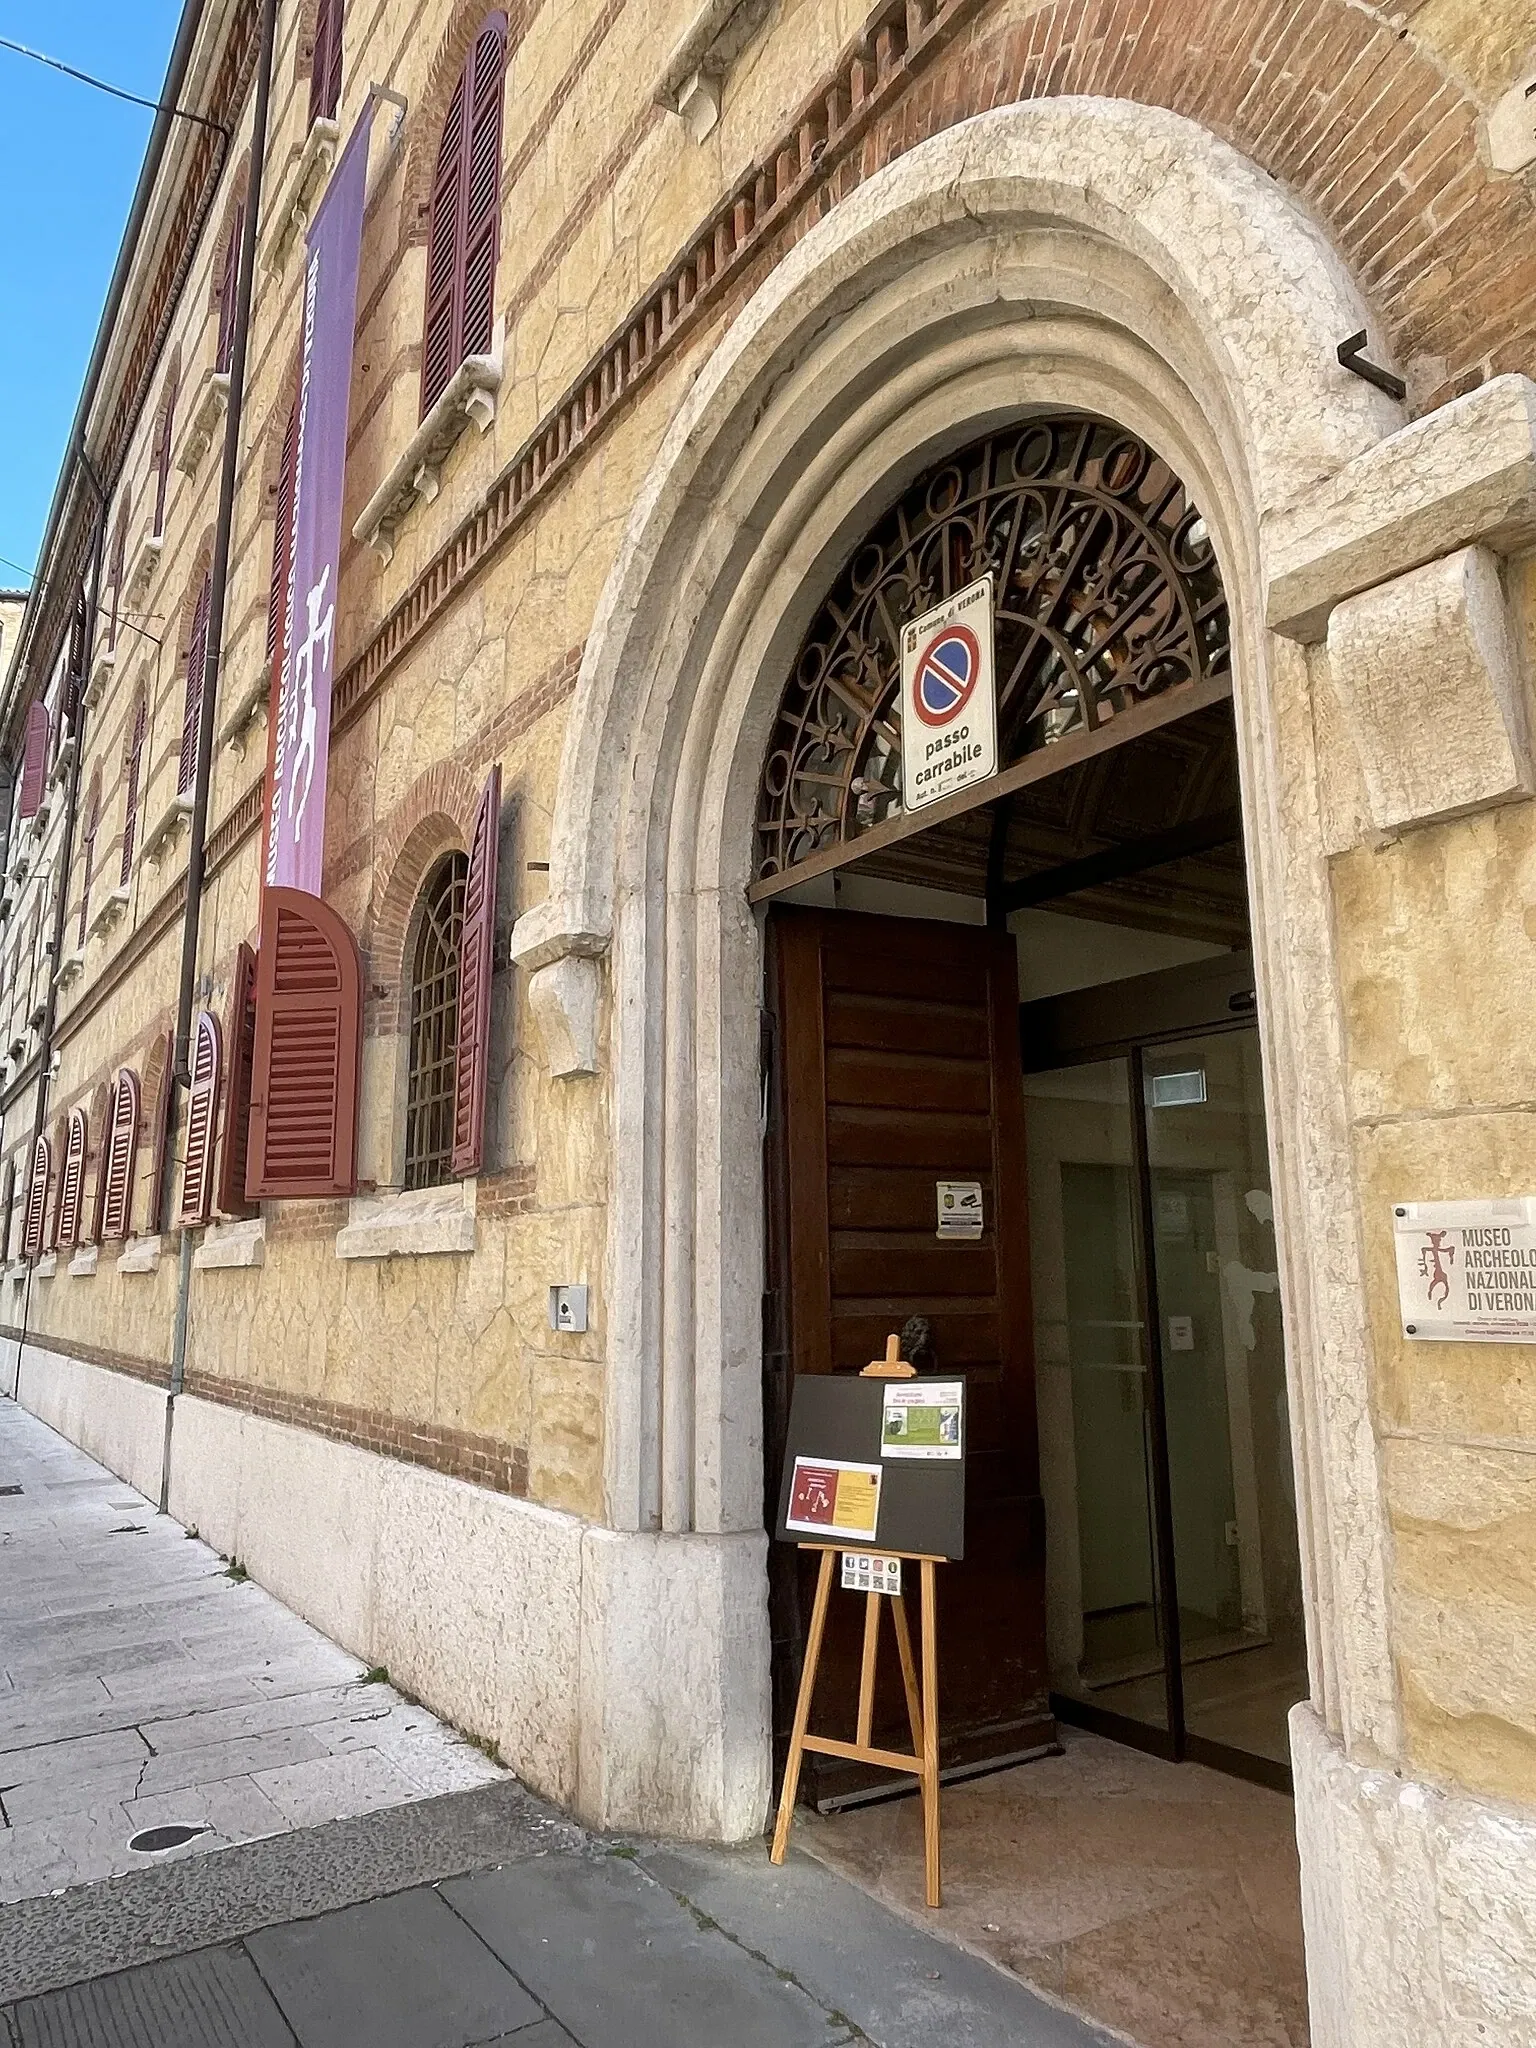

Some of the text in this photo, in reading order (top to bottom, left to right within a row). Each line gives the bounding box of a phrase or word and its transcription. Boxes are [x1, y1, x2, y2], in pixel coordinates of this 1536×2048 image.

[918, 614, 945, 635] Comune
[957, 587, 986, 611] VERONA
[925, 725, 970, 761] passo
[915, 743, 982, 786] carrabile
[266, 785, 283, 887] MUSEO
[1462, 1227, 1511, 1248] MUSEO
[1468, 1292, 1536, 1312] DI VERON
